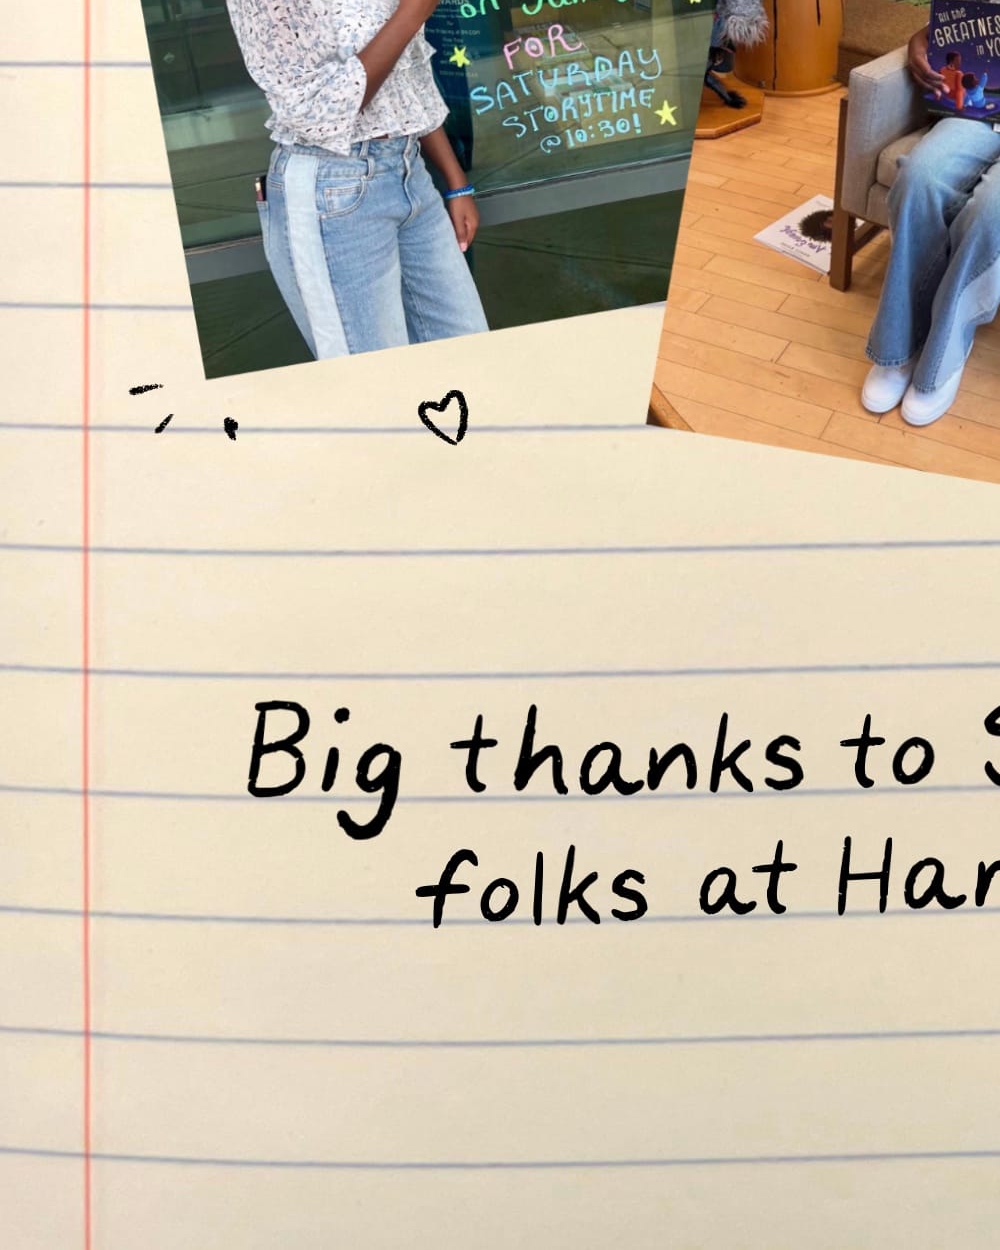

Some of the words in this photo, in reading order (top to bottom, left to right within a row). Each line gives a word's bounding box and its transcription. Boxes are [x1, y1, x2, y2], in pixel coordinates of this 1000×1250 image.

[503, 24, 583, 70] FOR
[470, 48, 662, 115] SATURDAY
[502, 88, 656, 138] STORYTIME
